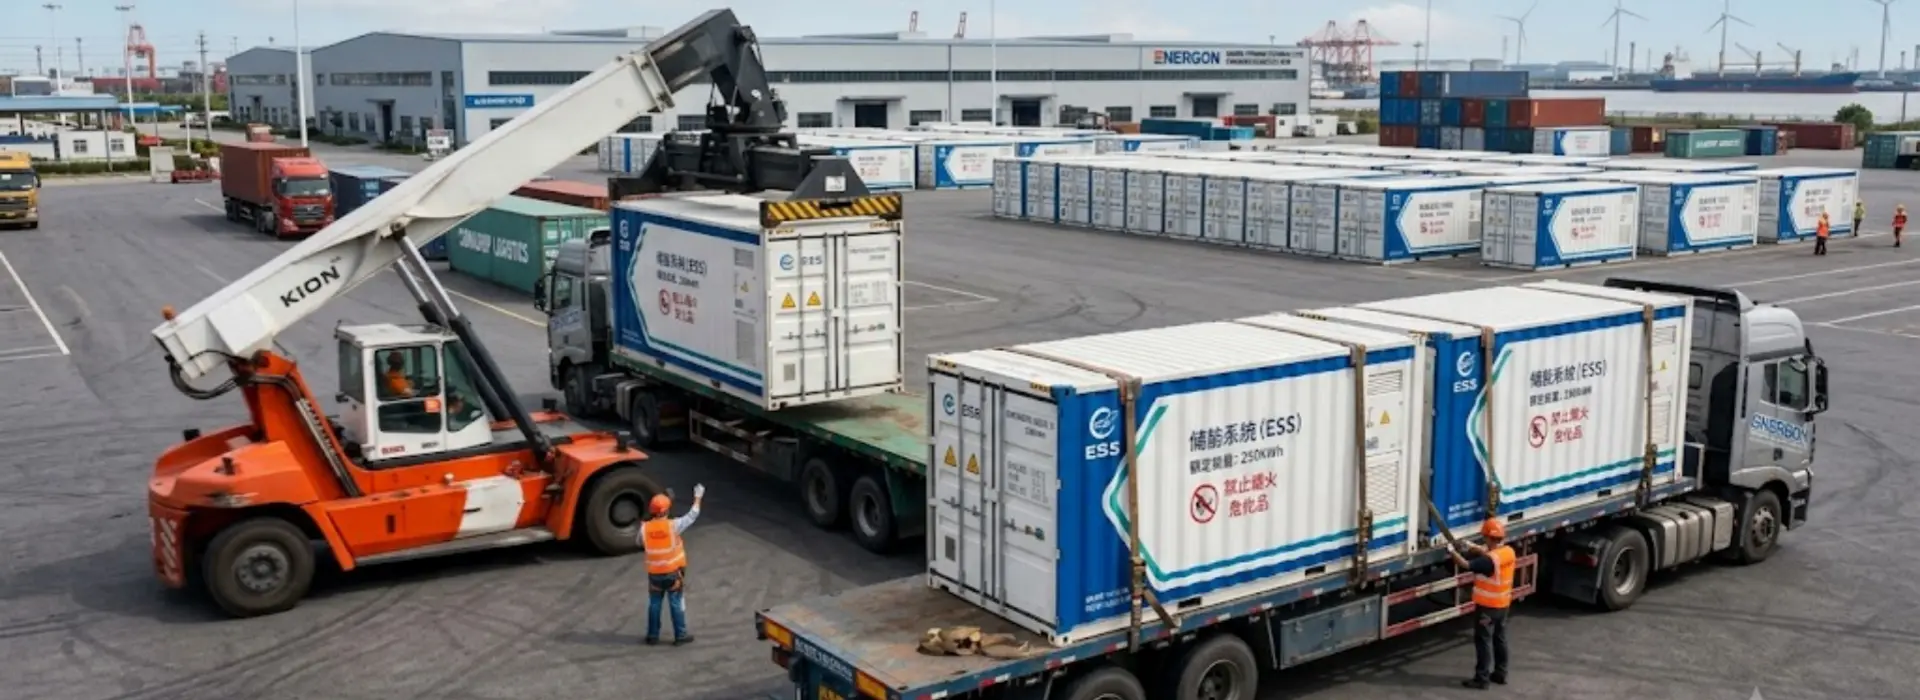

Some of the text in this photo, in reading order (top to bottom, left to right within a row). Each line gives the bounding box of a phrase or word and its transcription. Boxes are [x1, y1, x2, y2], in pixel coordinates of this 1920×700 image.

[280, 265, 341, 308] KION
[1453, 378, 1478, 393] ESS
[1085, 441, 1121, 460] ESS
